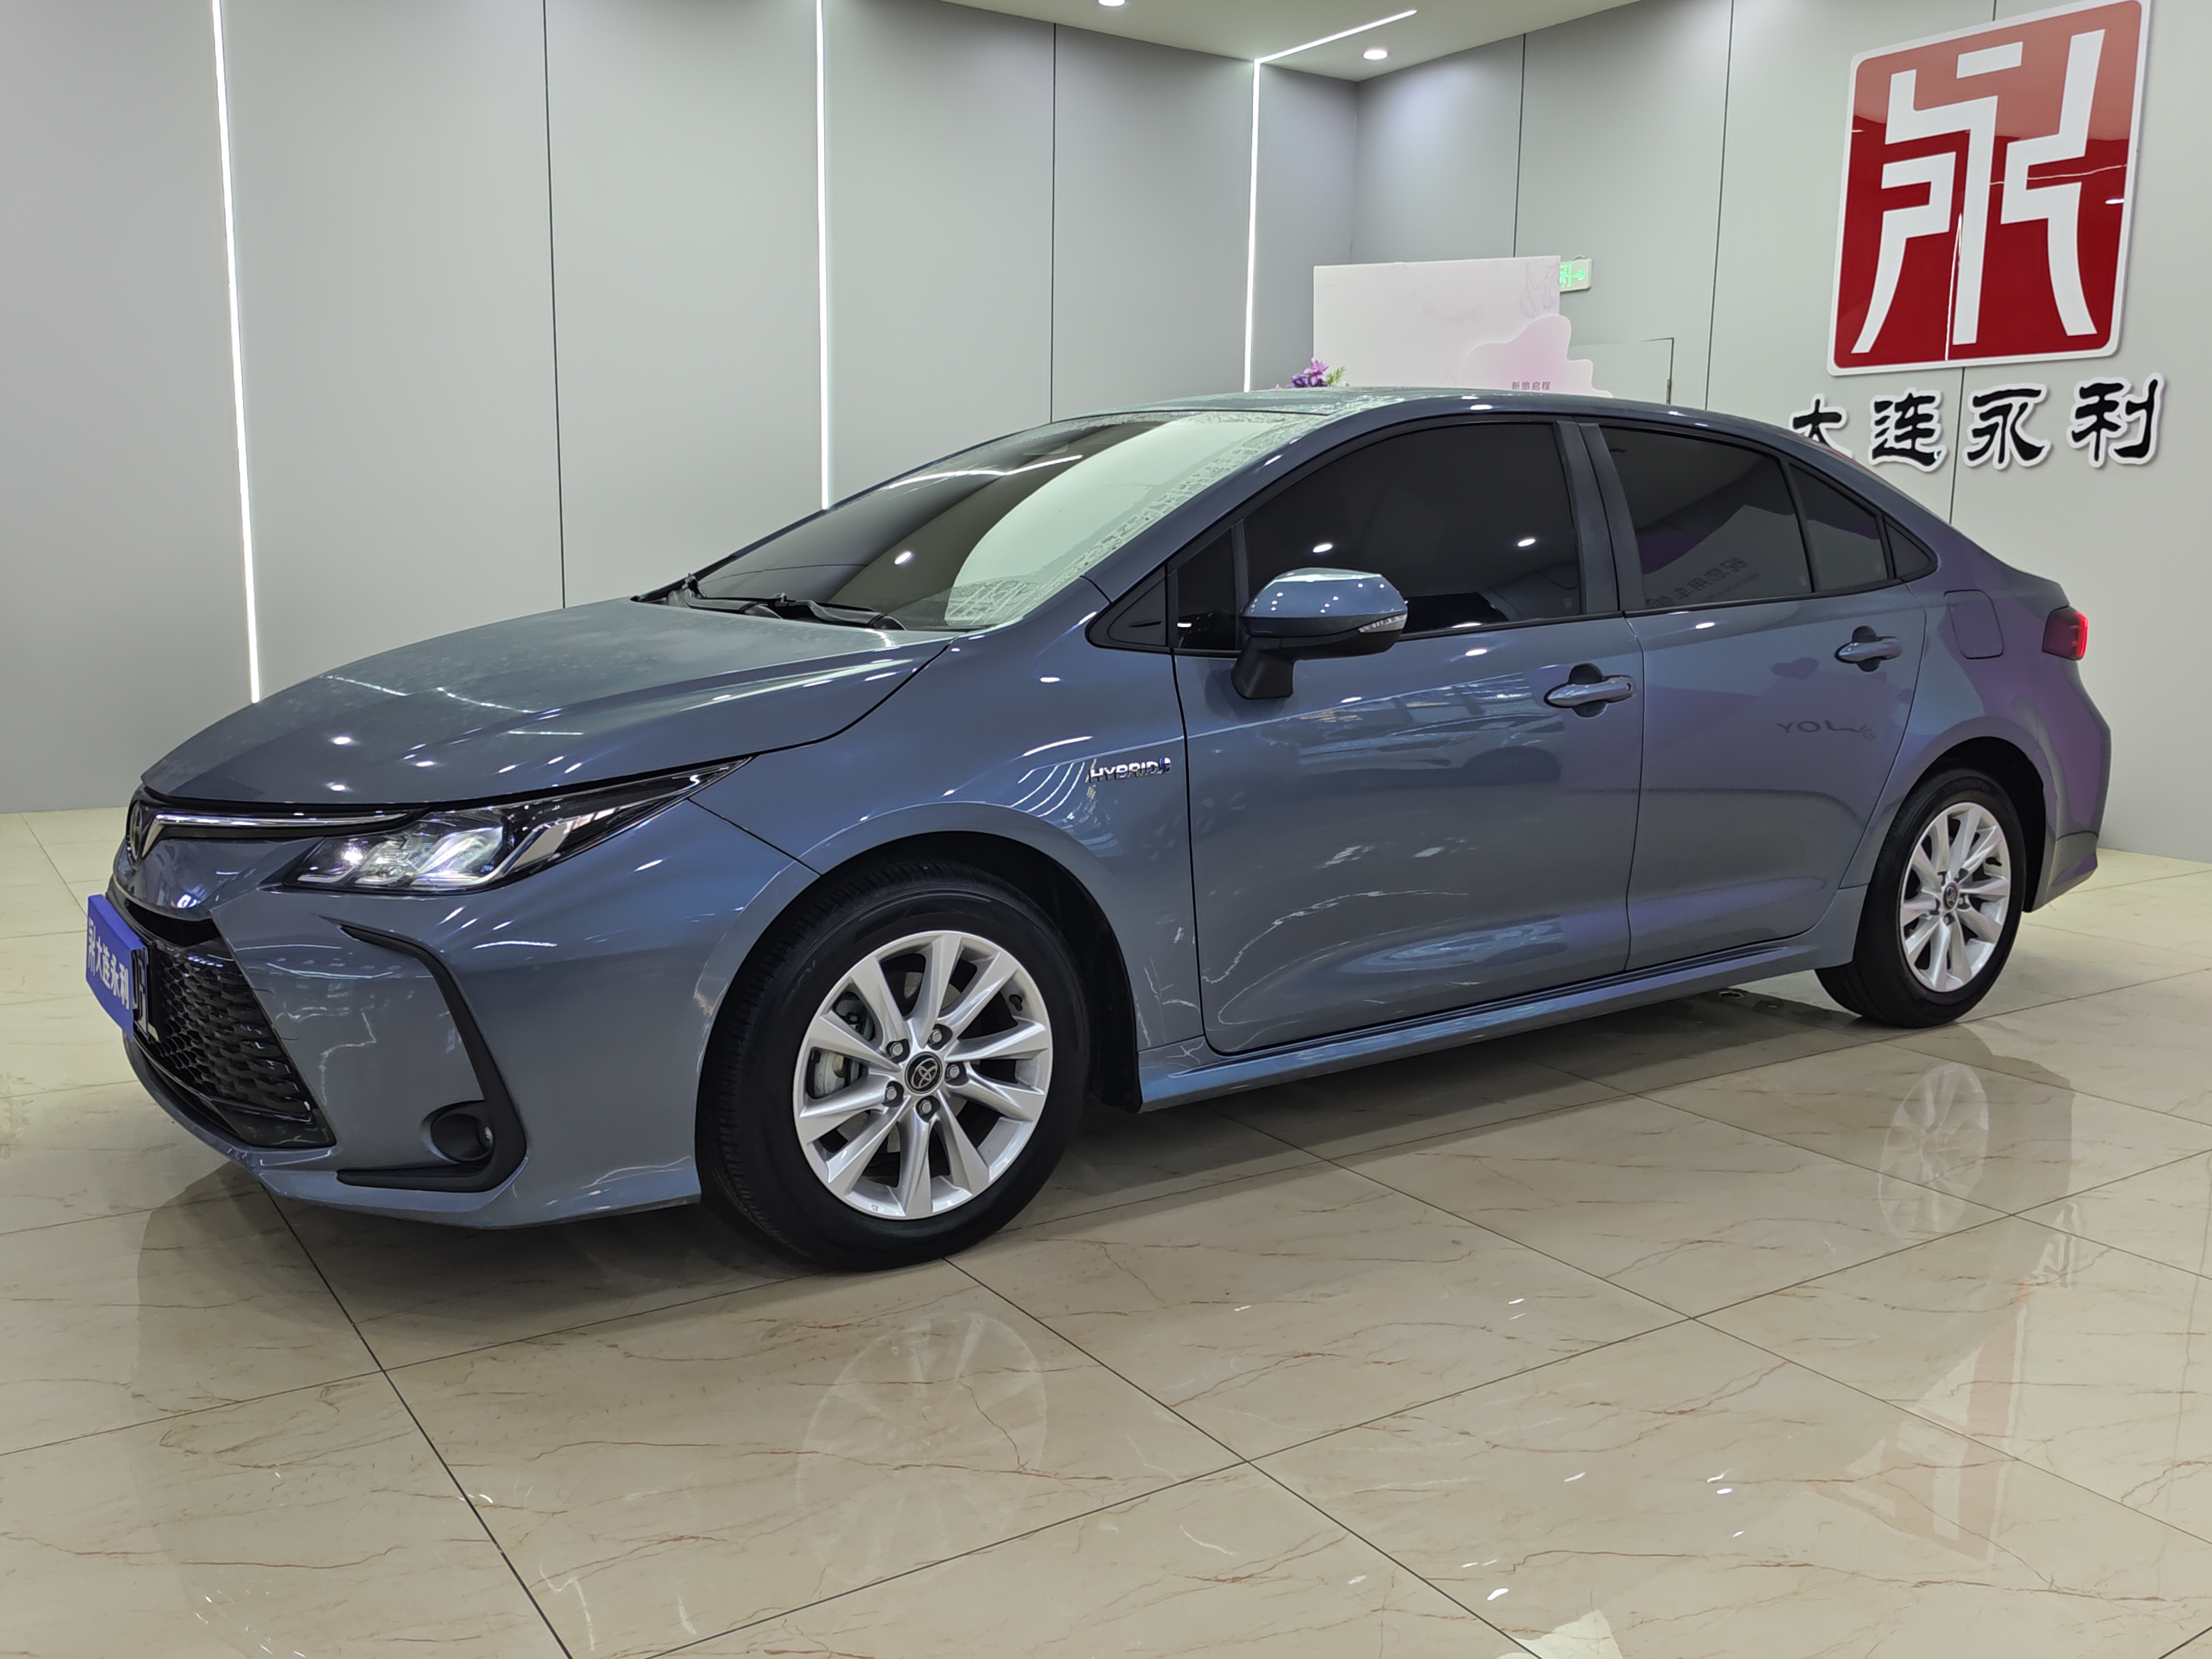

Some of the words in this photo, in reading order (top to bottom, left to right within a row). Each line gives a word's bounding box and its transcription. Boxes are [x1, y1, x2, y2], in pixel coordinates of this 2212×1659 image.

[1511, 381, 1551, 391] 新旅启程
[1790, 374, 2161, 468] 大连永利
[1090, 760, 1159, 783] HYBRID
